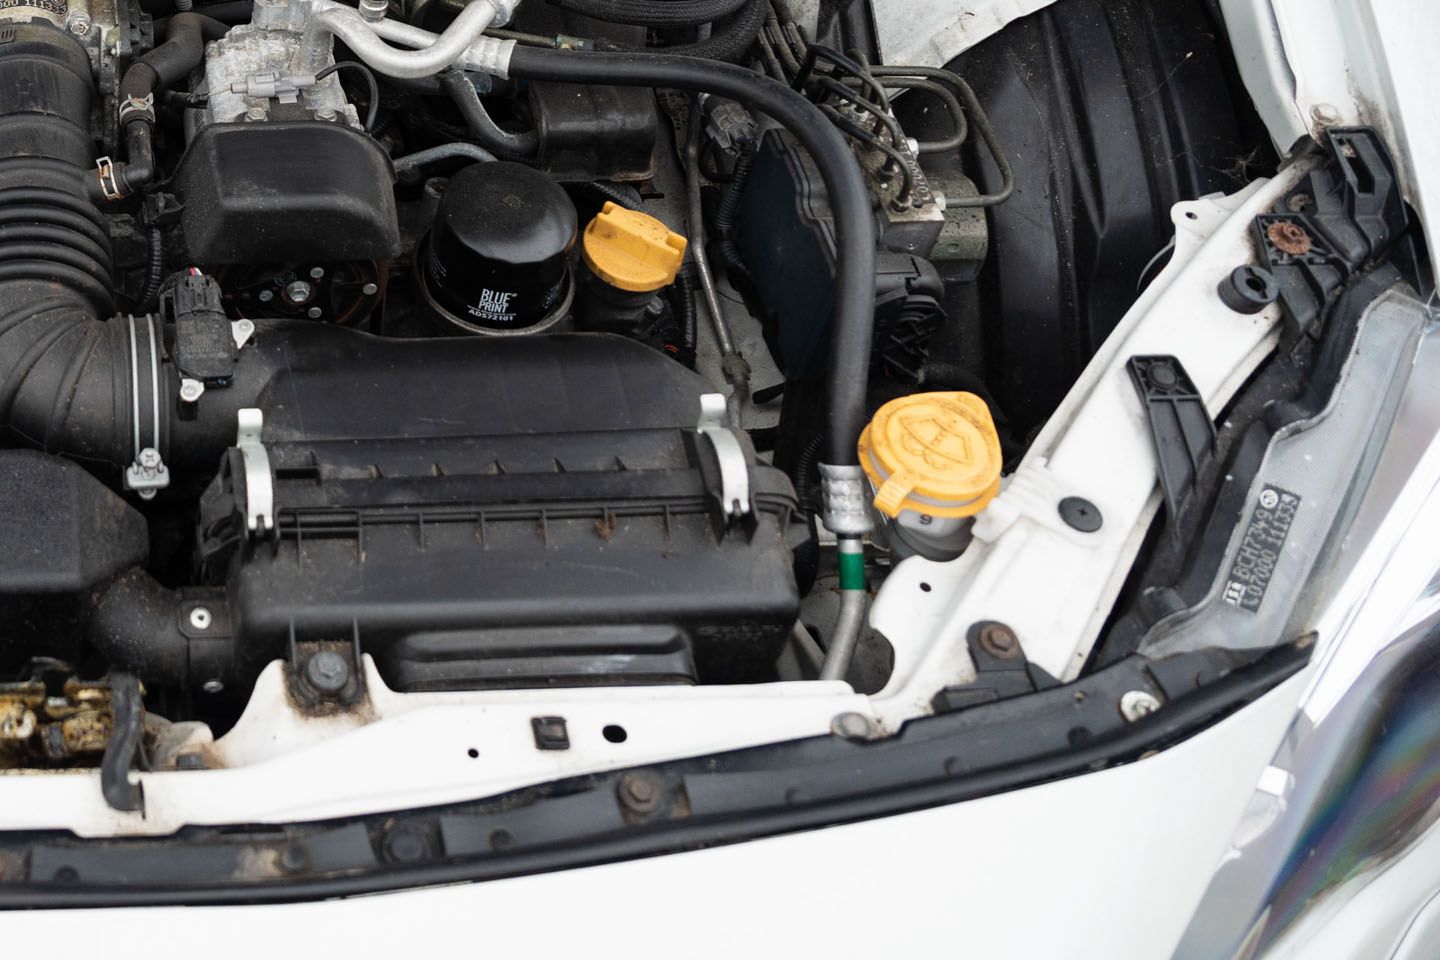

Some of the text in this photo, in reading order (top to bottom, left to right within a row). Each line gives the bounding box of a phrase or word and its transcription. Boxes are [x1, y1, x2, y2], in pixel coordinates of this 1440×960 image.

[480, 288, 512, 305] BLUE
[468, 309, 514, 321] ADS72101
[477, 300, 509, 314] PRINT
[1232, 508, 1274, 582] BCH7349
[1246, 548, 1278, 598] 07000
